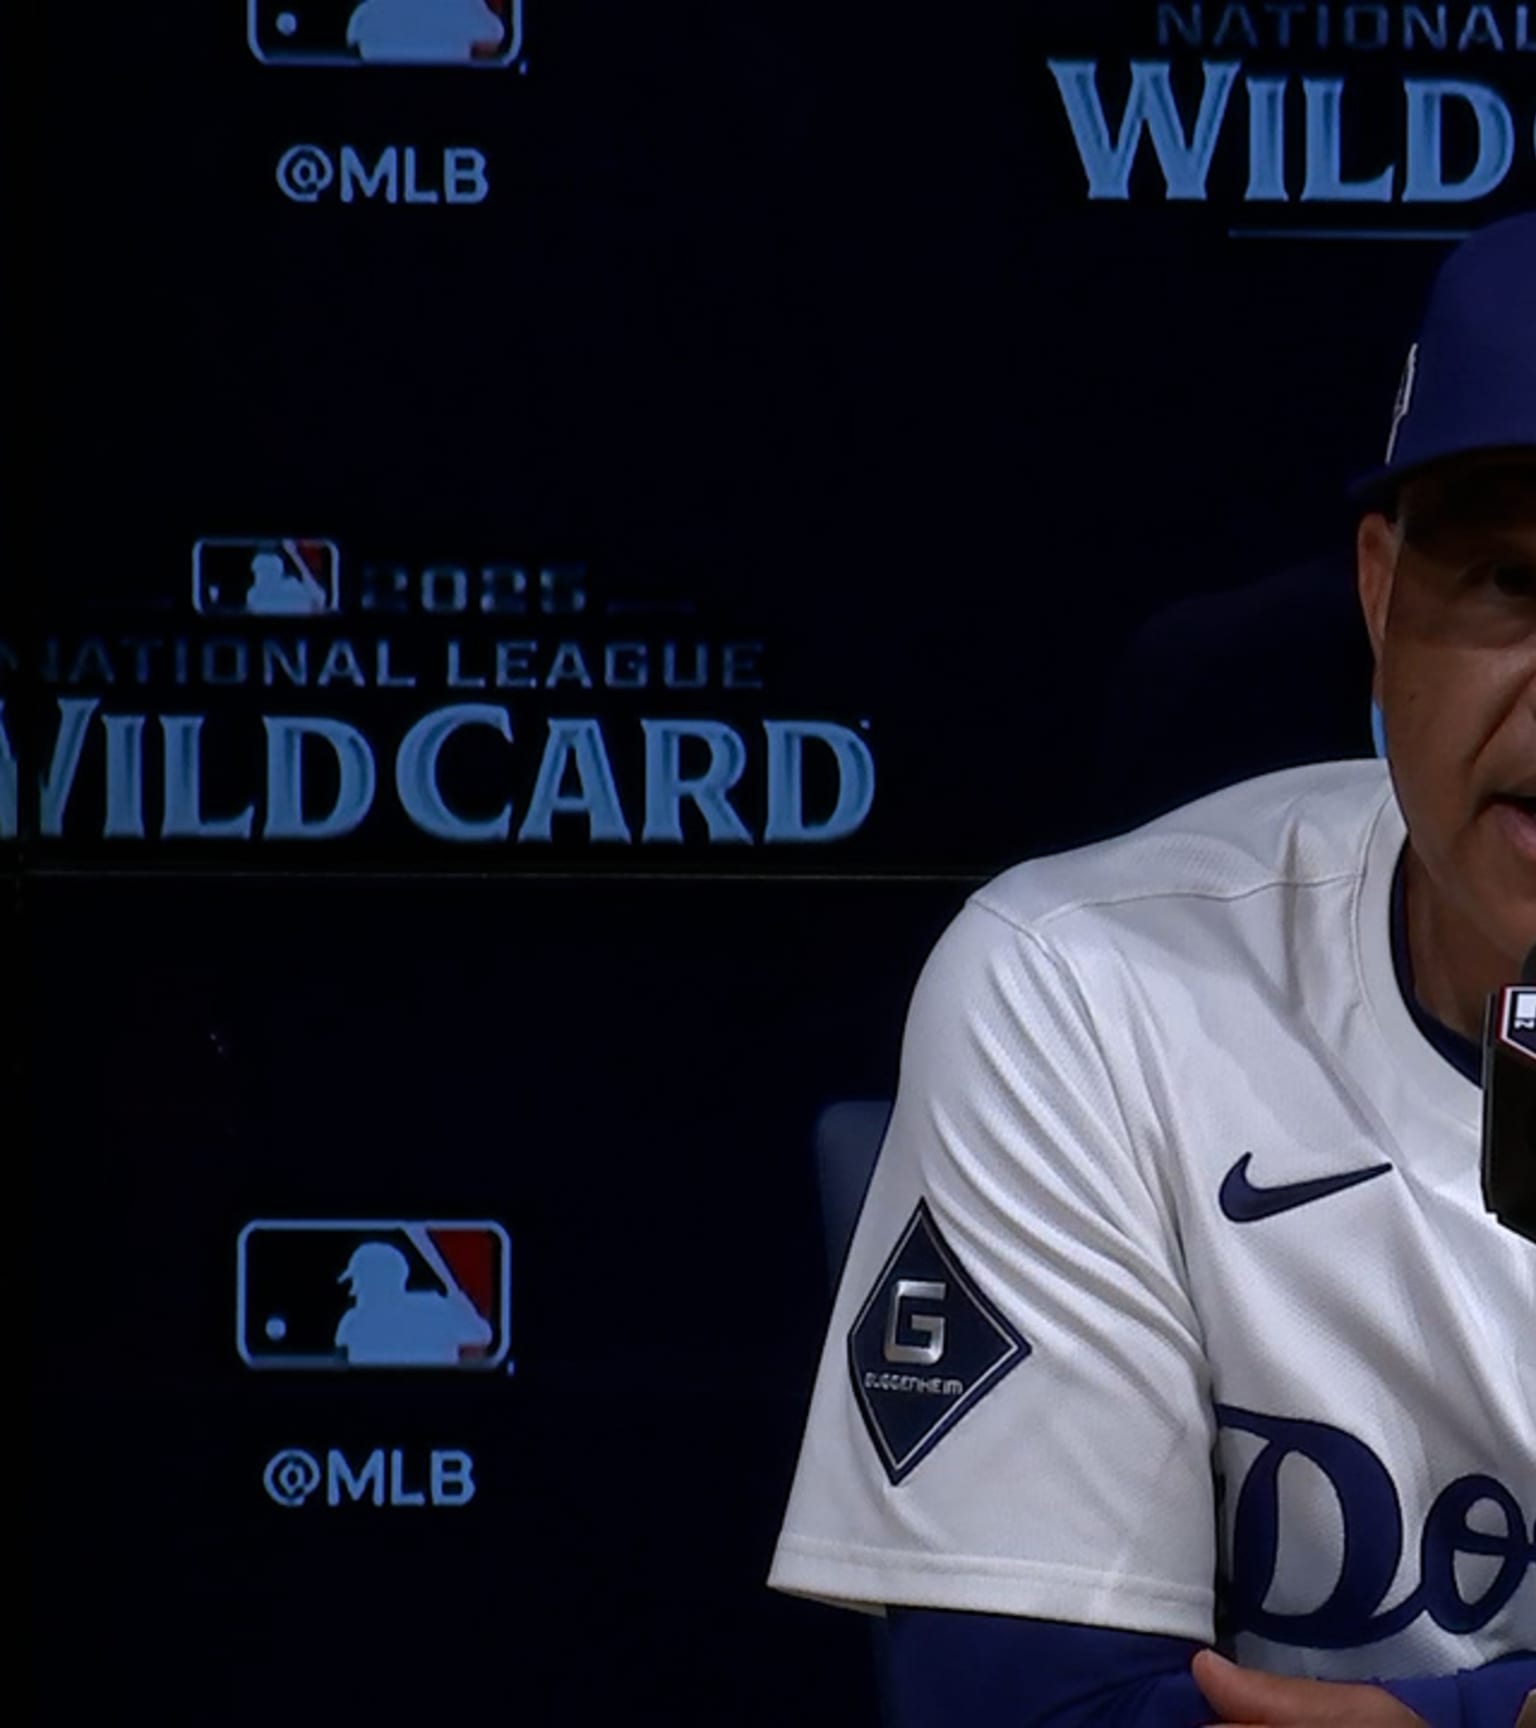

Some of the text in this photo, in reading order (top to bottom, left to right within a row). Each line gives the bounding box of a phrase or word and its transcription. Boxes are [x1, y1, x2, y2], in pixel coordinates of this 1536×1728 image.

[276, 145, 490, 204] @MLB
[360, 564, 588, 614] 2025
[446, 639, 765, 690] LEAGUE
[882, 1278, 947, 1366] G
[263, 1448, 477, 1507] @MLB
